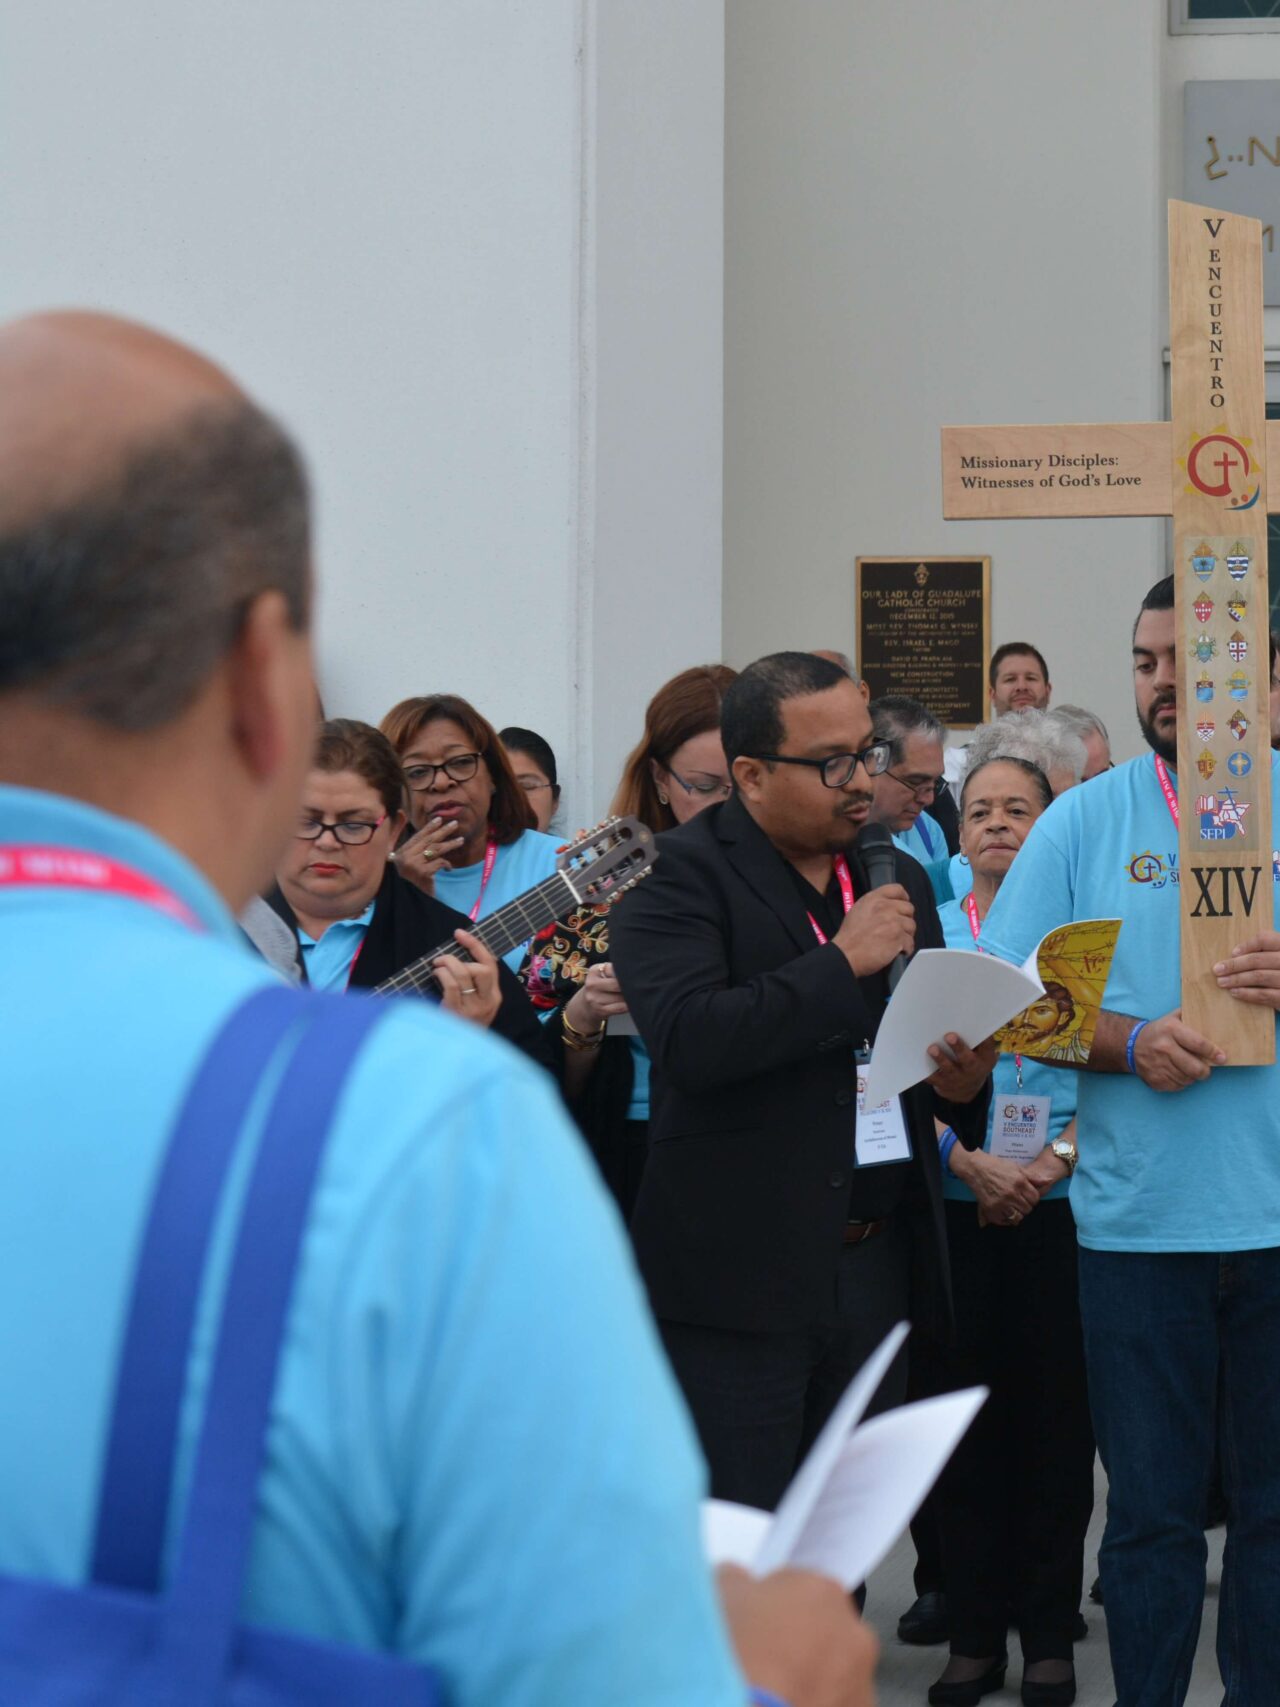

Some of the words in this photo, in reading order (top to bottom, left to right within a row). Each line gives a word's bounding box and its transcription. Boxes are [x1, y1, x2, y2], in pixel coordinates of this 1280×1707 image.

[1203, 219, 1224, 238] V
[1209, 249, 1224, 407] ENCUENTRO
[961, 456, 1042, 471] Missionary
[1048, 454, 1118, 470] Disciples:
[961, 476, 1034, 488] Witnesses
[1040, 475, 1054, 487] of
[1059, 472, 1100, 486] God's
[1106, 474, 1141, 485] Love
[877, 598, 924, 607] CATHOLIC
[927, 598, 966, 607] CHURCH
[885, 590, 908, 599] LADY
[911, 590, 925, 599] OF
[1200, 827, 1227, 840] SEPI
[1190, 867, 1262, 917] XIV
